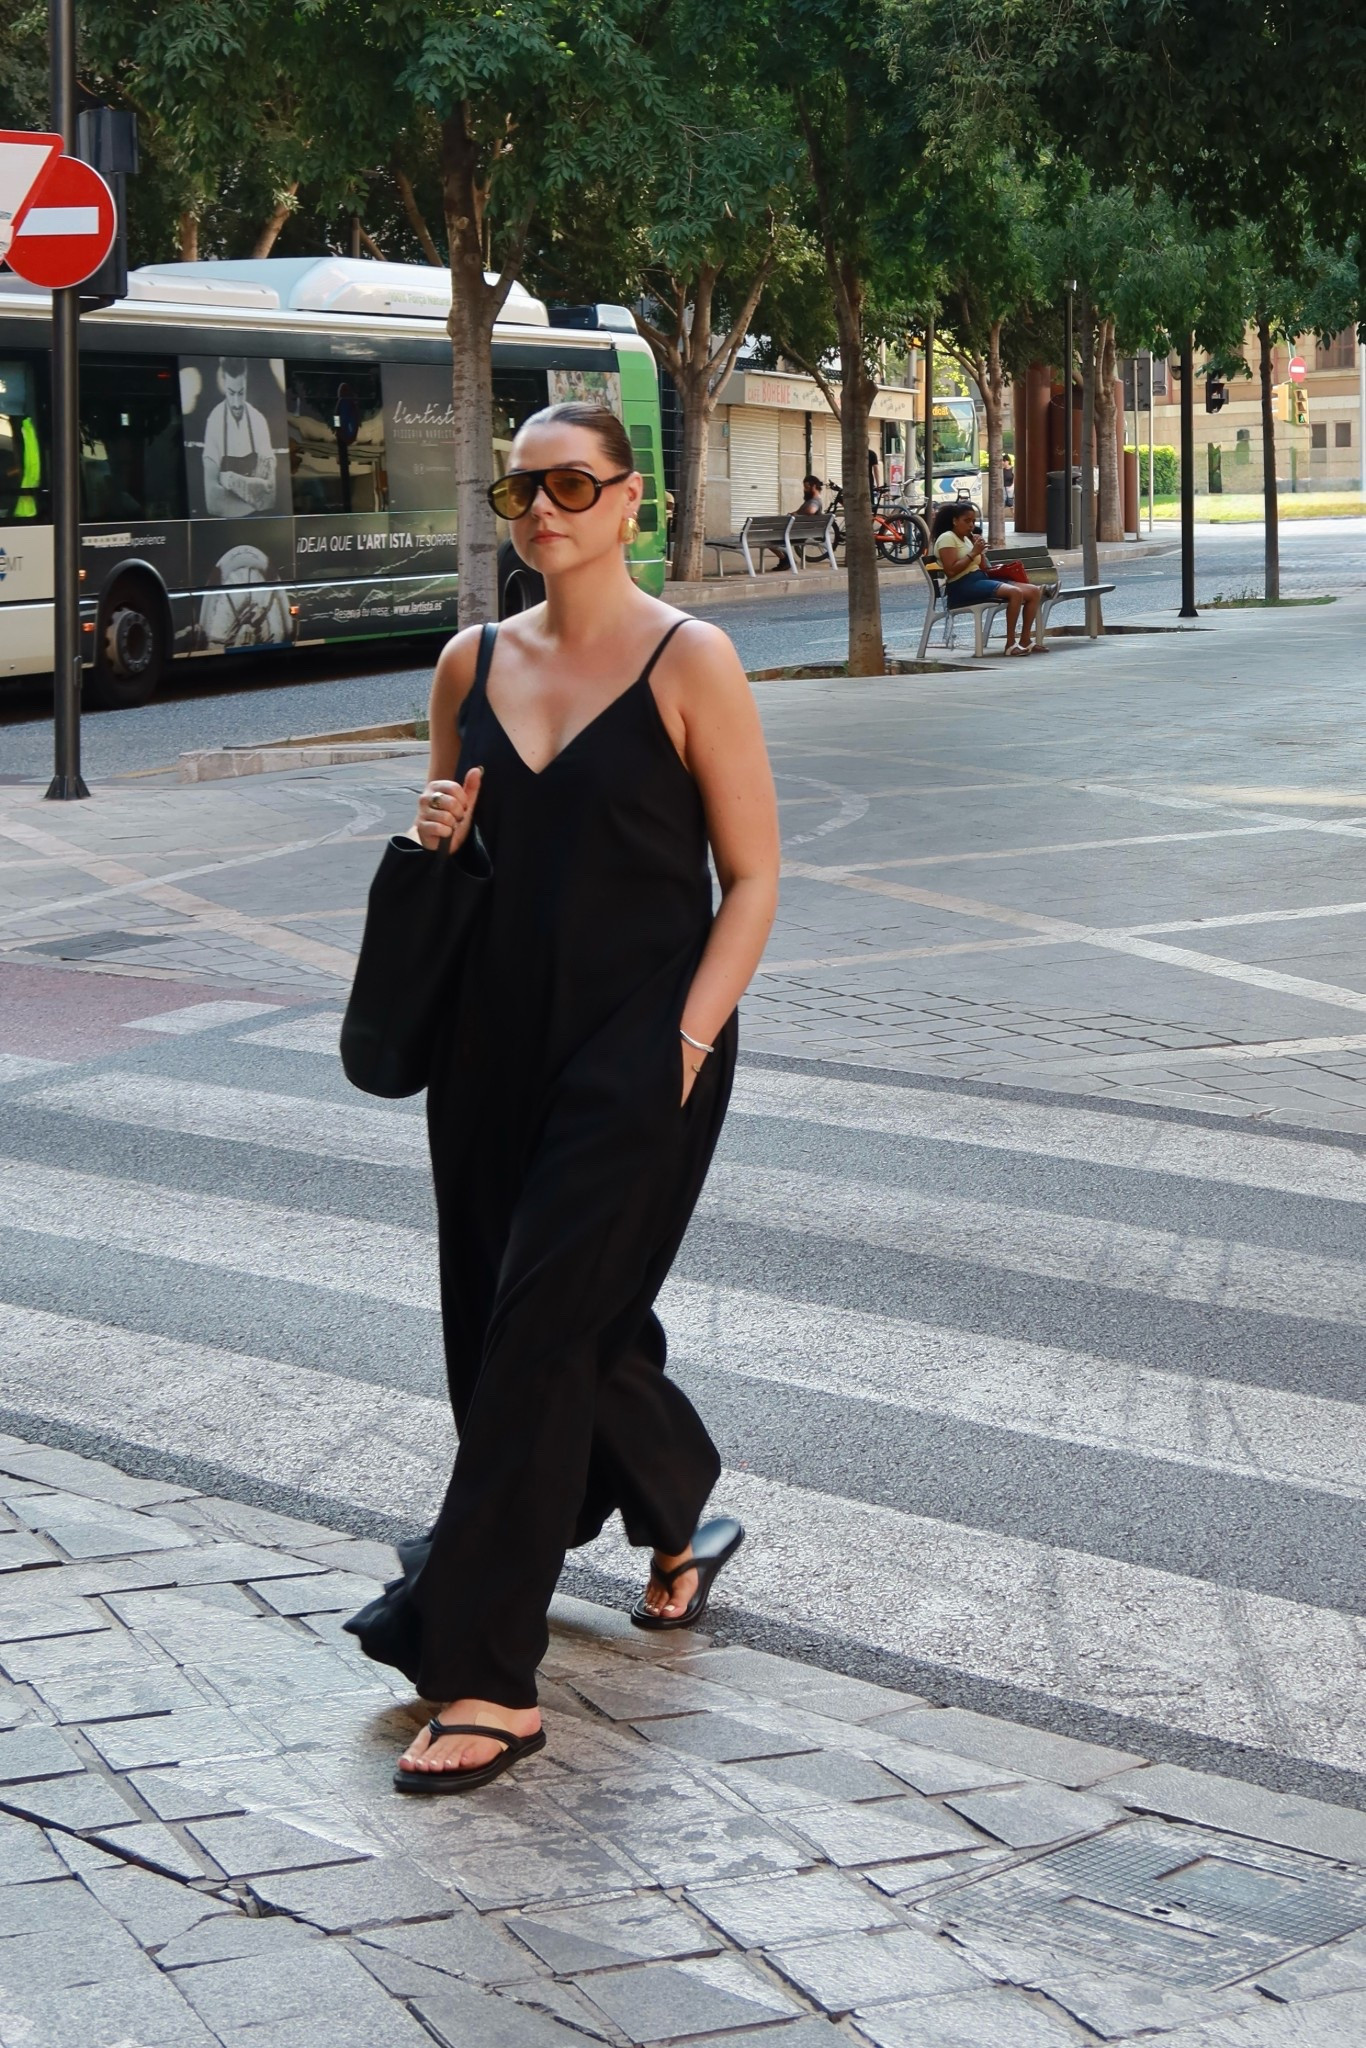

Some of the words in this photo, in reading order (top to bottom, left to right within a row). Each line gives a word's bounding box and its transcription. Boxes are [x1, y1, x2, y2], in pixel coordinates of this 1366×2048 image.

[329, 535, 353, 551] QUE
[415, 534, 425, 547] TE
[425, 533, 457, 547] SORPRE
